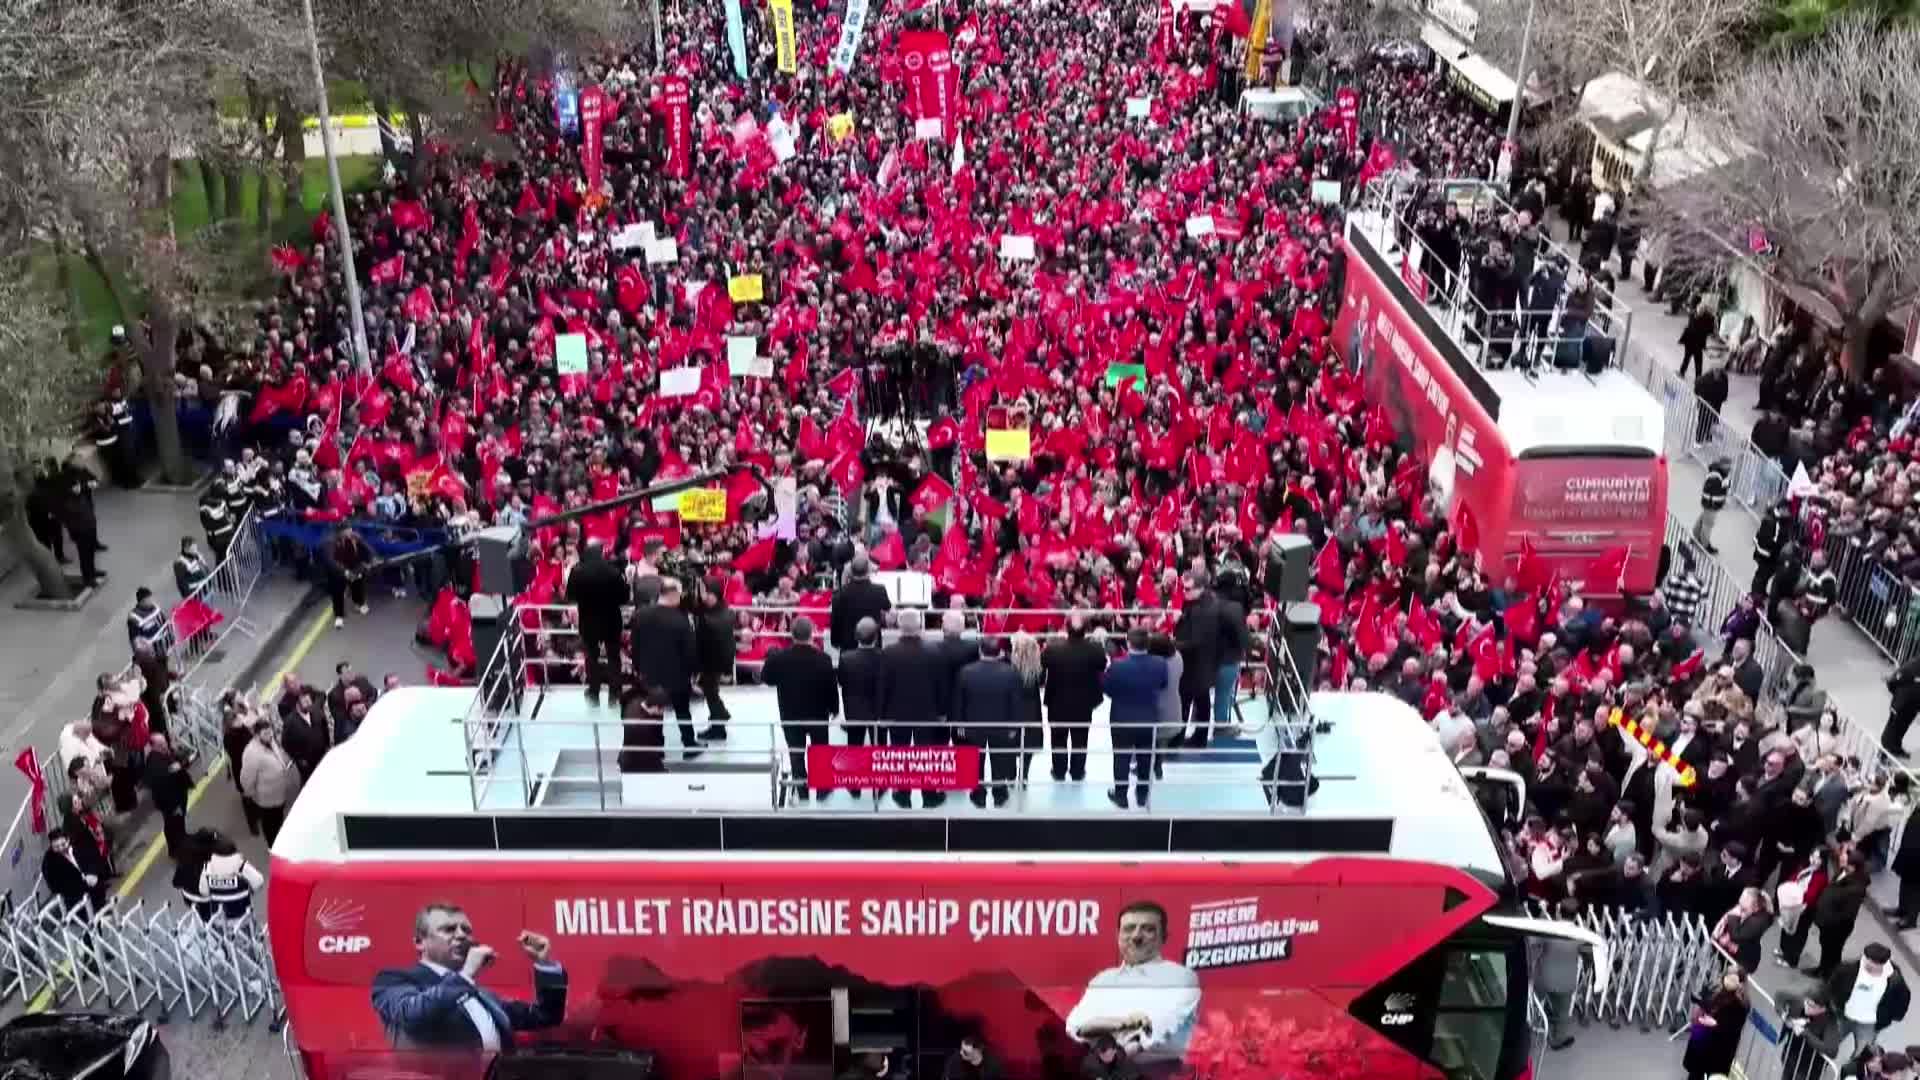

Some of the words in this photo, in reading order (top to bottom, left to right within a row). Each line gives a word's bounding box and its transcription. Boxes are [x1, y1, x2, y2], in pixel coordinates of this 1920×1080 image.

[871, 761, 905, 773] HALK
[969, 899, 1100, 942] ÇIKIYOR
[1189, 904, 1258, 929] EKREM
[318, 934, 371, 953] CHP
[1380, 1013, 1414, 1025] CHP
